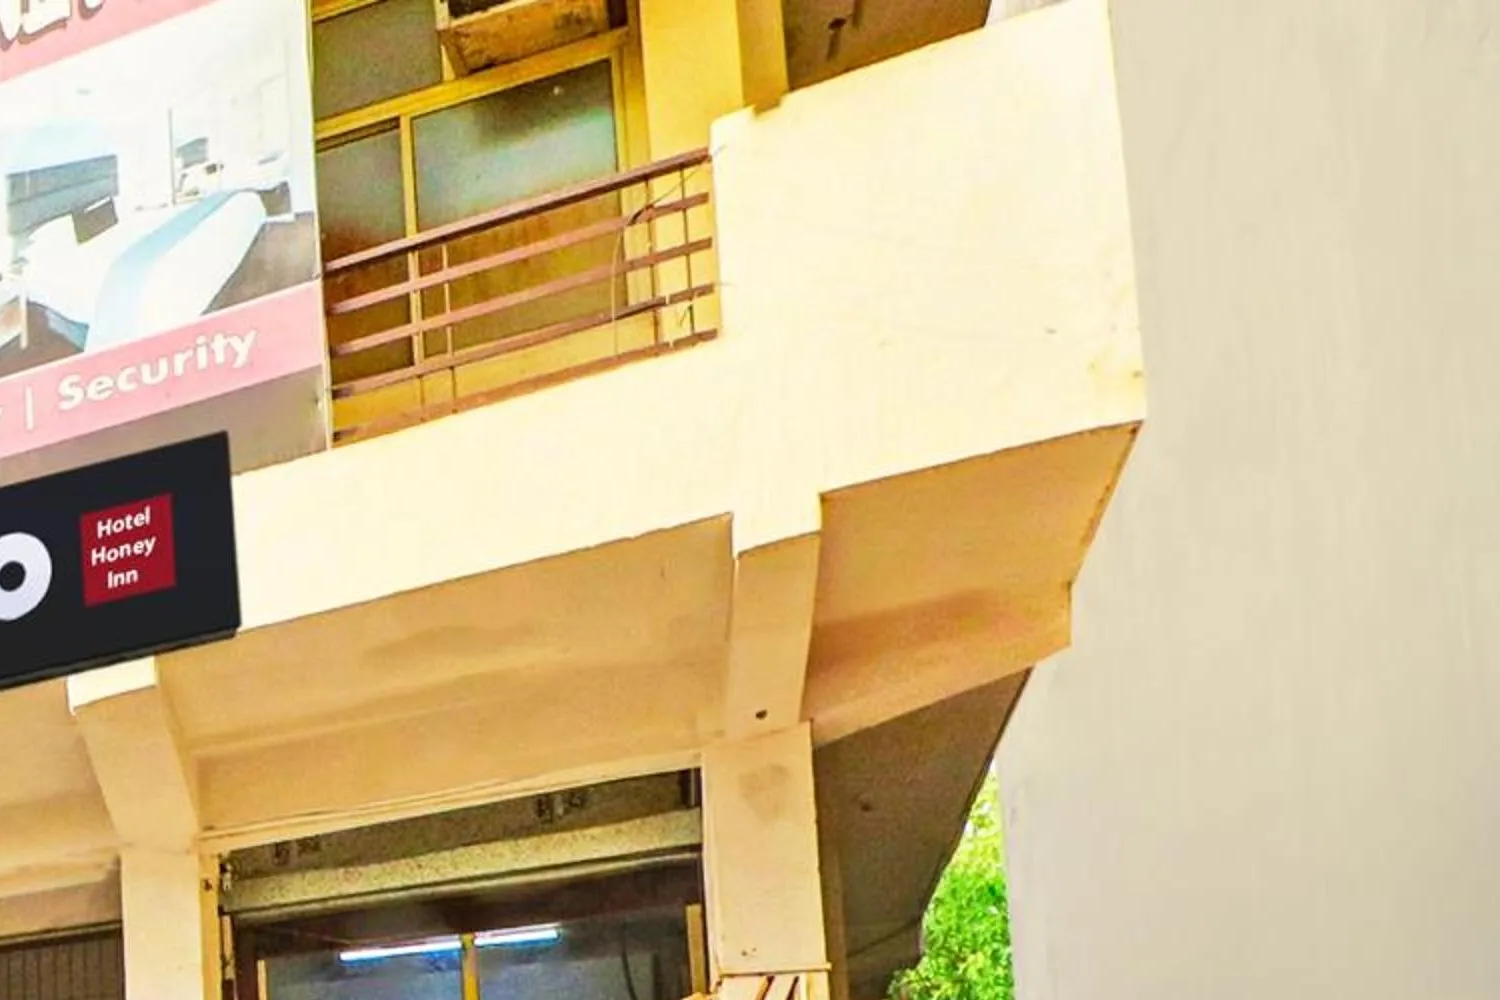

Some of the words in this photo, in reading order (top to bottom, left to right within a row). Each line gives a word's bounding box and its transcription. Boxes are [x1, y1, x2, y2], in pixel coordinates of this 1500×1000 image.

[57, 327, 260, 412] Security
[96, 506, 152, 539] Hotel
[90, 537, 157, 567] Honey
[106, 567, 139, 589] Inn
